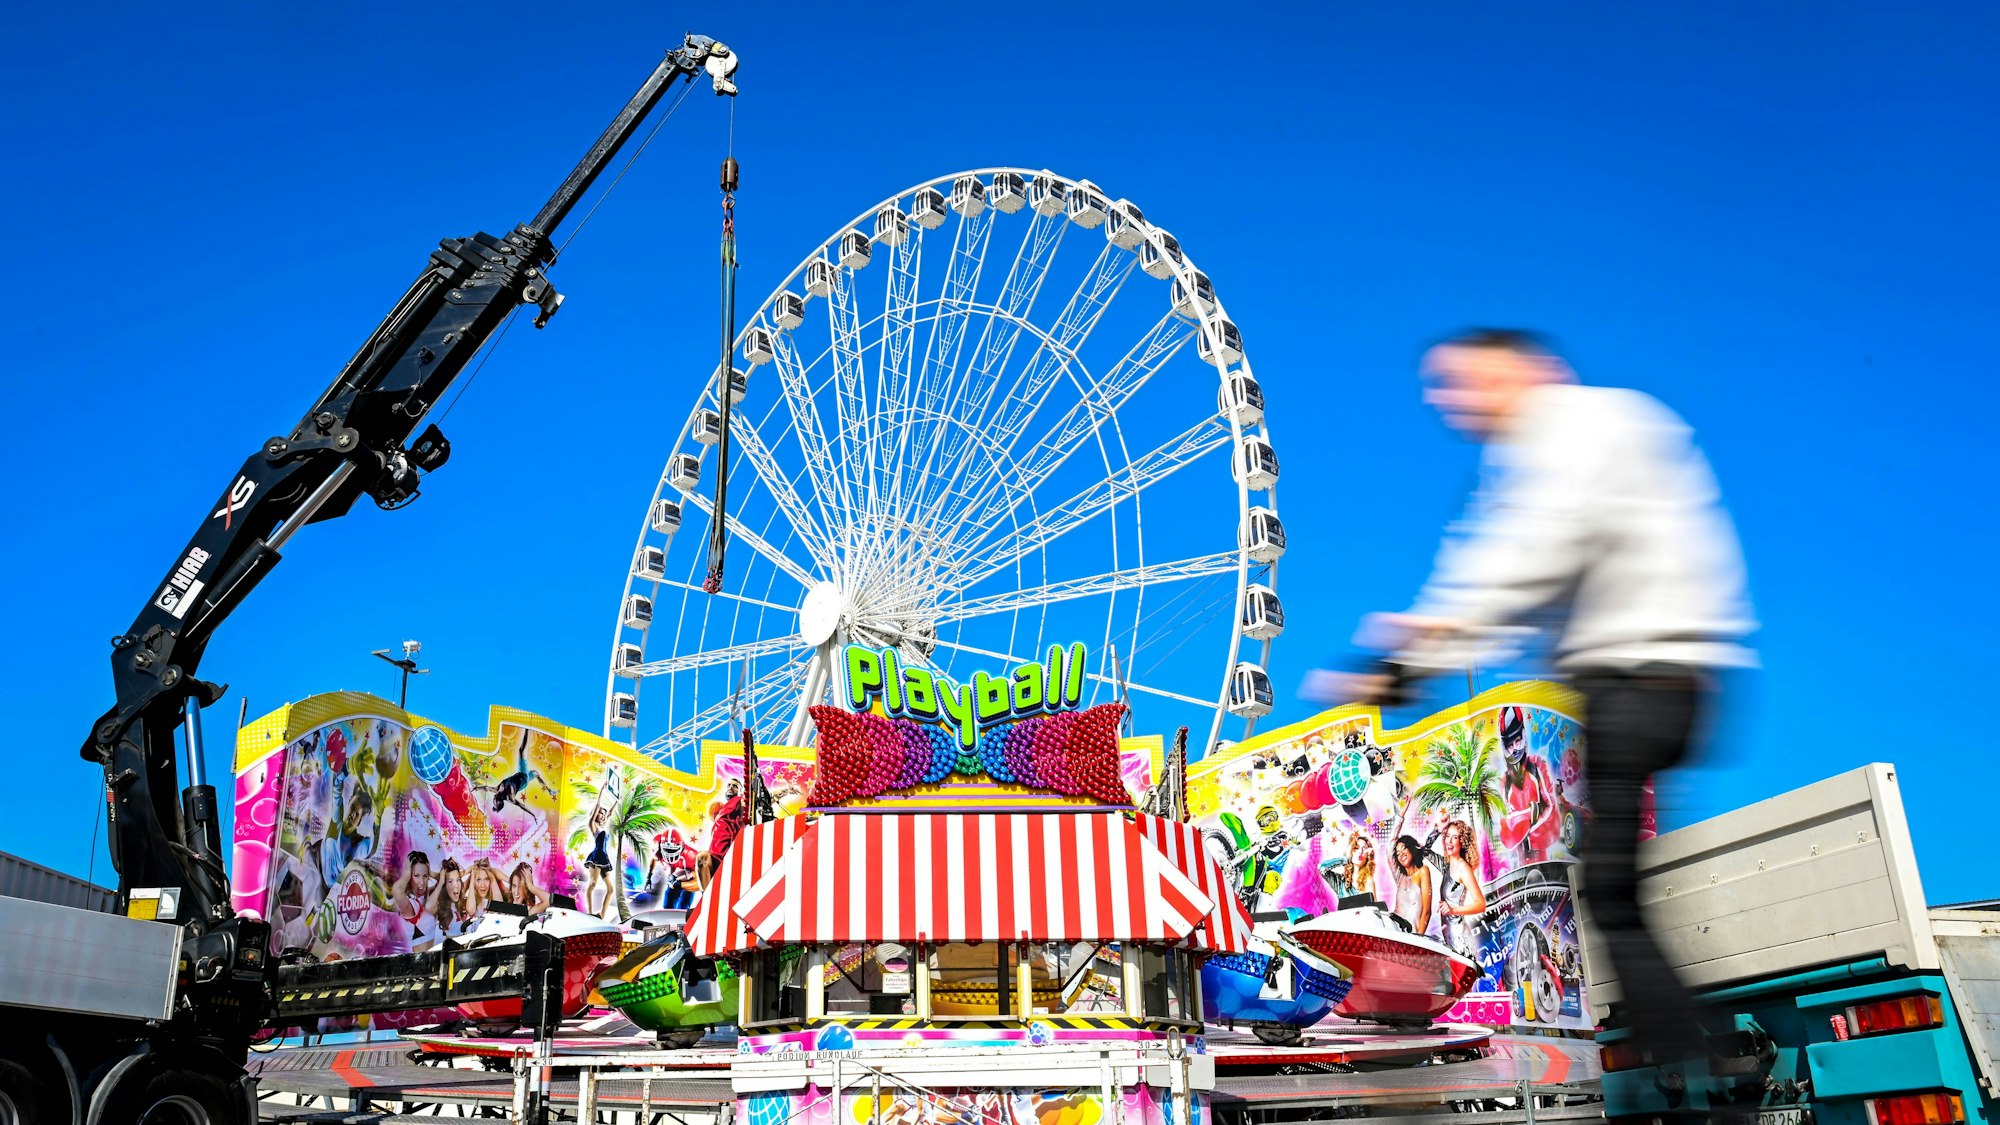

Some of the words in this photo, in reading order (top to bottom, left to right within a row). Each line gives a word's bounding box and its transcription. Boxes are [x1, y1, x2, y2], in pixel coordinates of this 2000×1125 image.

[213, 475, 257, 532] XS
[170, 546, 210, 591] HIAB
[844, 642, 1086, 751] Playball
[338, 894, 370, 911] FLORIDA
[1514, 902, 1532, 920] 140
[1493, 910, 1510, 927] 120
[1538, 904, 1554, 925] 160
[1563, 915, 1577, 935] 18
[777, 1052, 810, 1061] PODIUM
[816, 1050, 863, 1059] RUNDLAUF
